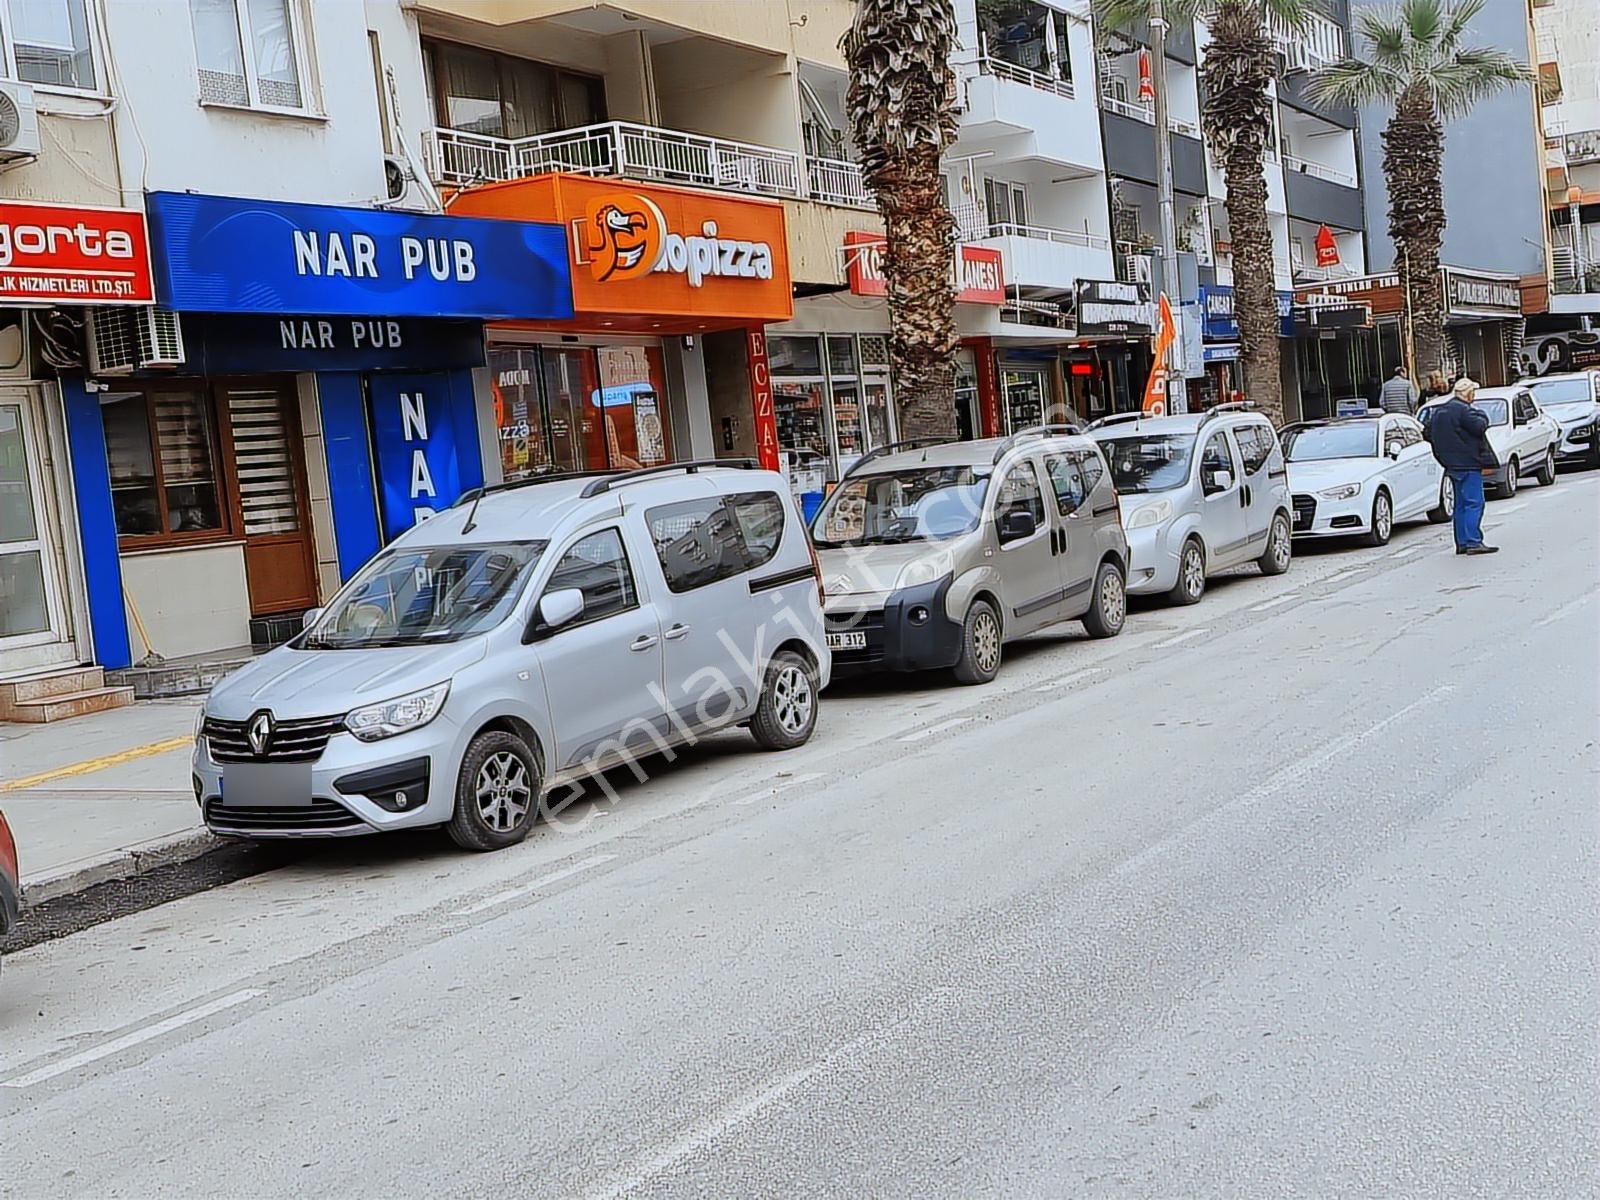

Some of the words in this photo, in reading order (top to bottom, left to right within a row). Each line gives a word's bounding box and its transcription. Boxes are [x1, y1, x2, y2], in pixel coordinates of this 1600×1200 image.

[293, 230, 379, 278] NAR
[401, 237, 476, 282] PUB
[279, 320, 335, 349] NAR
[351, 321, 402, 349] PUB
[845, 633, 865, 647] 312
